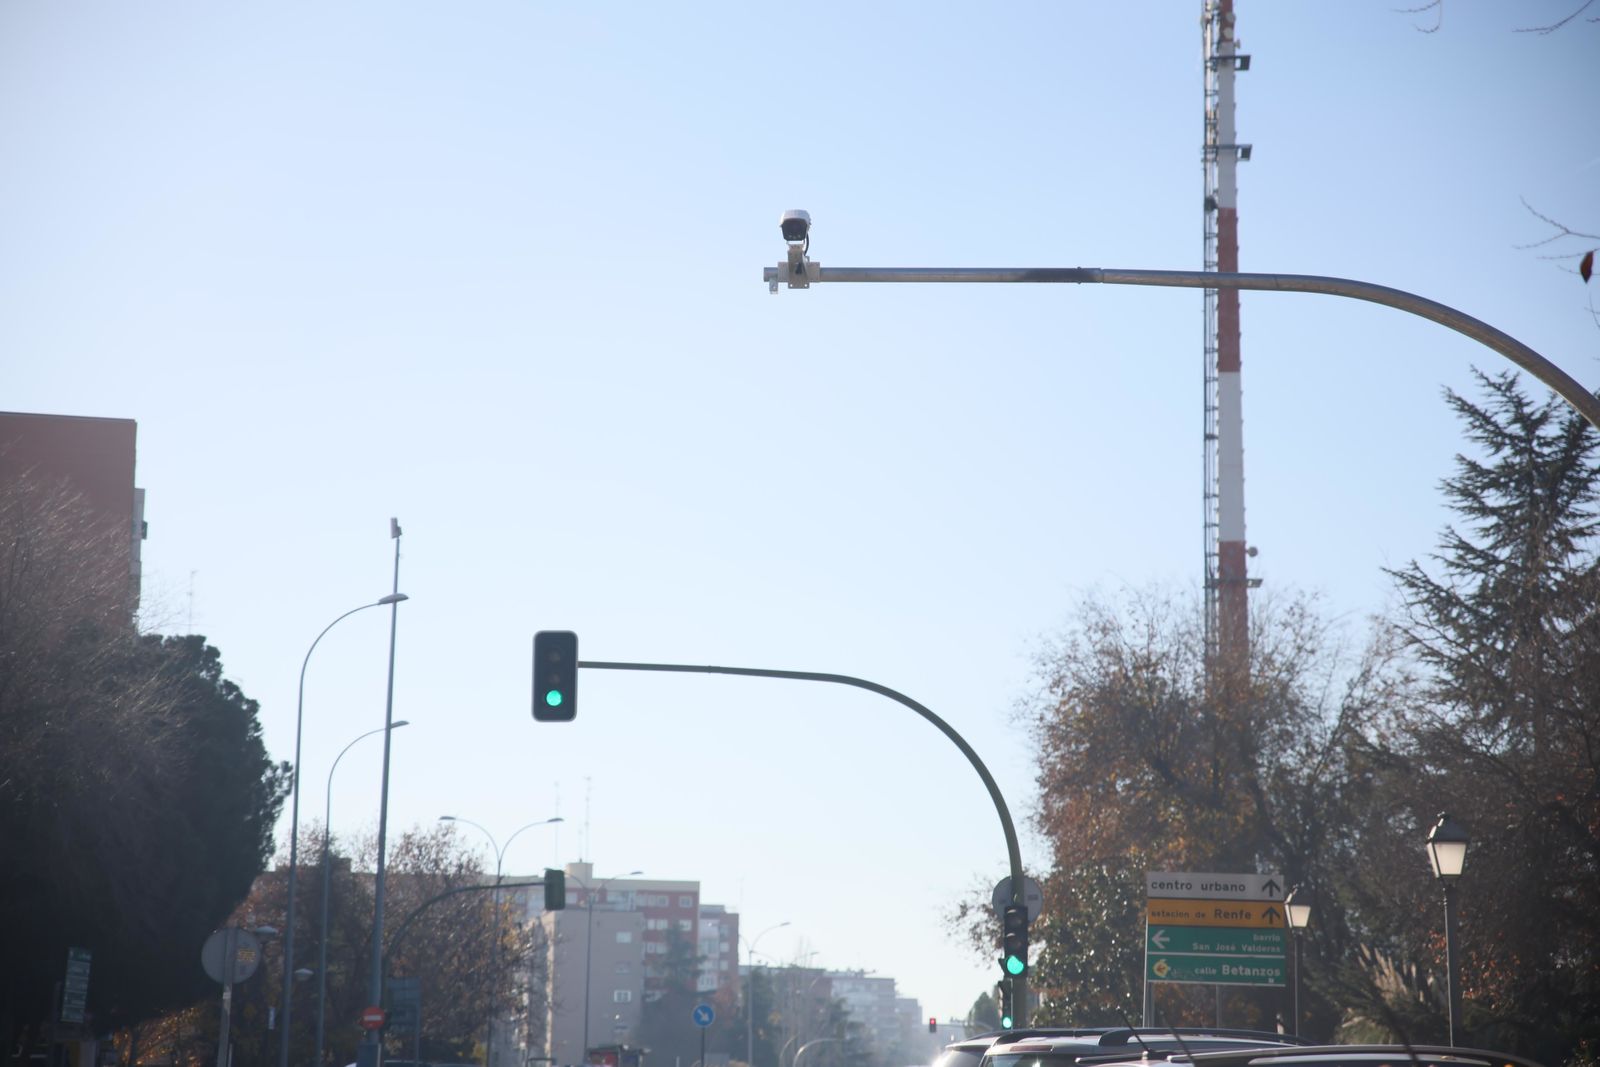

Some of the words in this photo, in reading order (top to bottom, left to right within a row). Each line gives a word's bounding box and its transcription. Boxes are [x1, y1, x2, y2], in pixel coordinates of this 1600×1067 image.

[1151, 880, 1192, 890] centro
[1201, 882, 1246, 892] urbano
[1214, 909, 1252, 920] Renfe
[1192, 943, 1209, 951] San
[1194, 967, 1216, 975] calle
[1222, 965, 1280, 976] Betanzos
